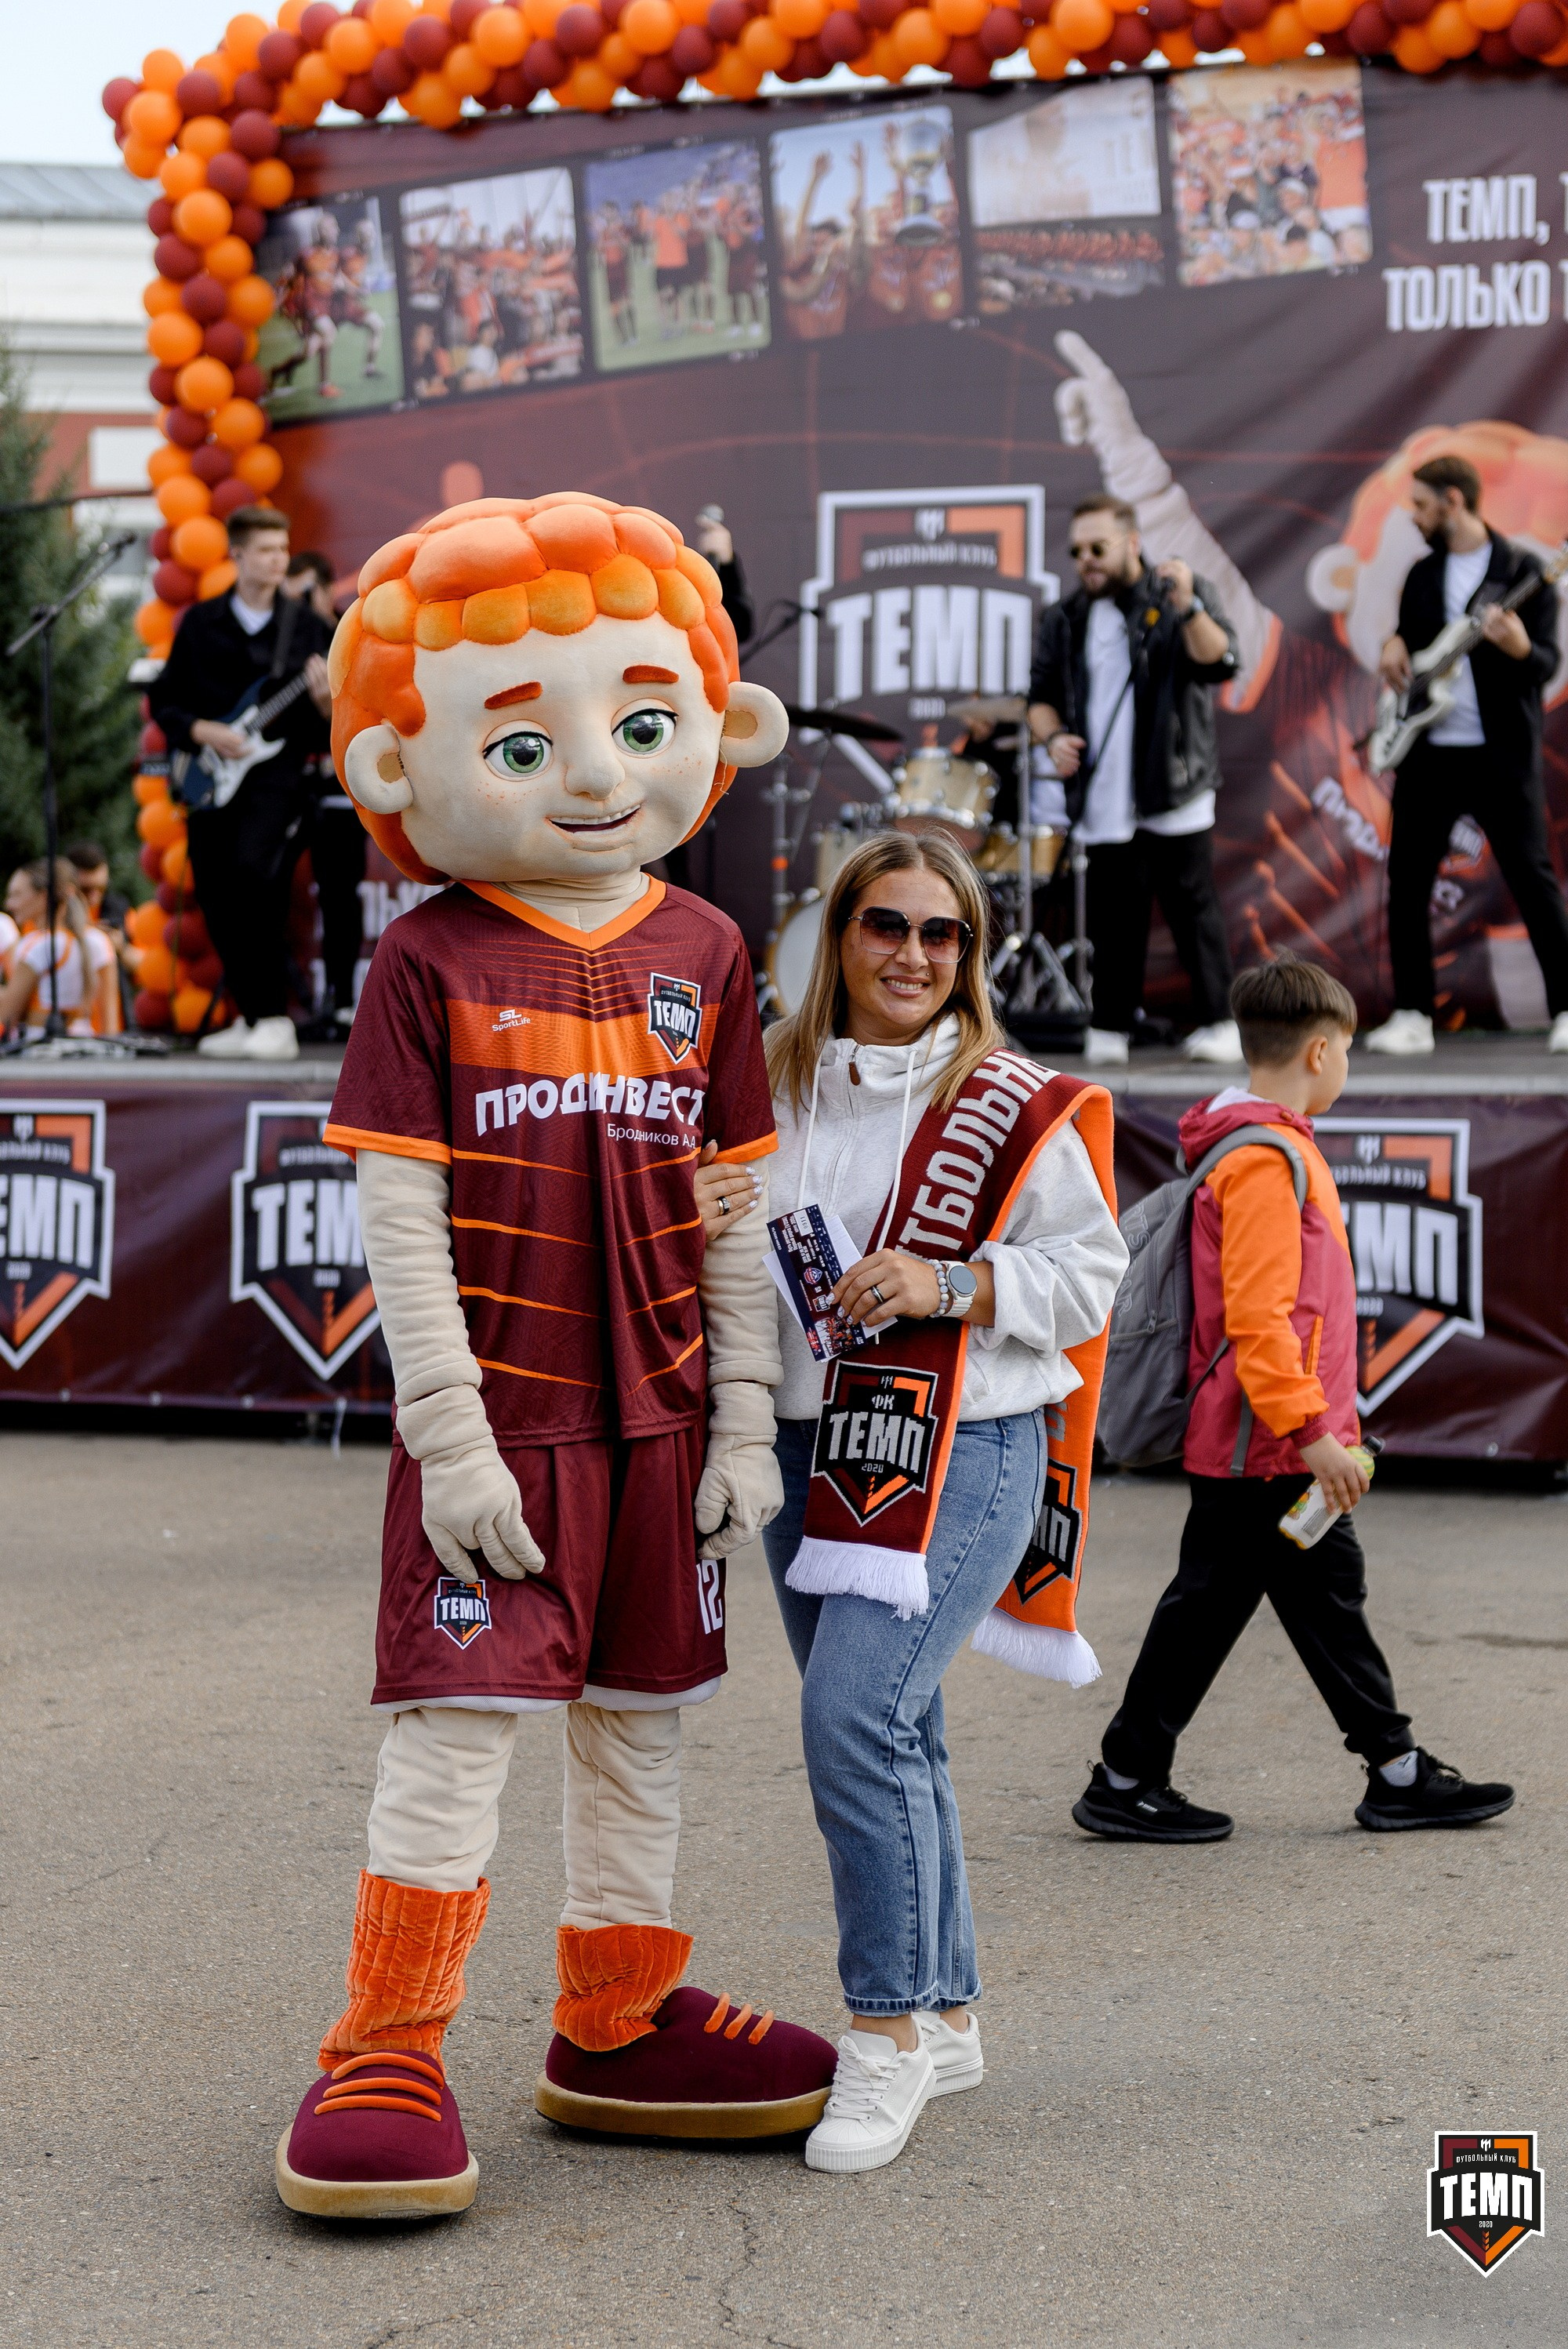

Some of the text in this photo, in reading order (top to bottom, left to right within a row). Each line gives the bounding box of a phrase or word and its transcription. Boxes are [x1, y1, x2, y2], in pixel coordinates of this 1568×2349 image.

[1422, 174, 1551, 246] ТЕМП,
[1382, 260, 1552, 332] ТОЛЬКО
[826, 584, 1033, 704] ТЕМП
[492, 1017, 531, 1032] SportLife
[654, 1000, 696, 1038] ТЕМП
[476, 1072, 706, 1137] ПРОДИНВЕСТ
[608, 1123, 679, 1145] Бродников
[895, 1051, 1062, 1264] ТБОЛЬН
[0, 1174, 95, 1269] МП
[251, 1179, 365, 1273] ТЕМ
[1341, 1201, 1458, 1307] МП
[872, 1395, 895, 1410] ФК
[828, 1411, 925, 1473] ТЕМП
[862, 1463, 884, 1473] 2020
[440, 1597, 486, 1621] ТЕМП
[696, 1559, 723, 1635] 12
